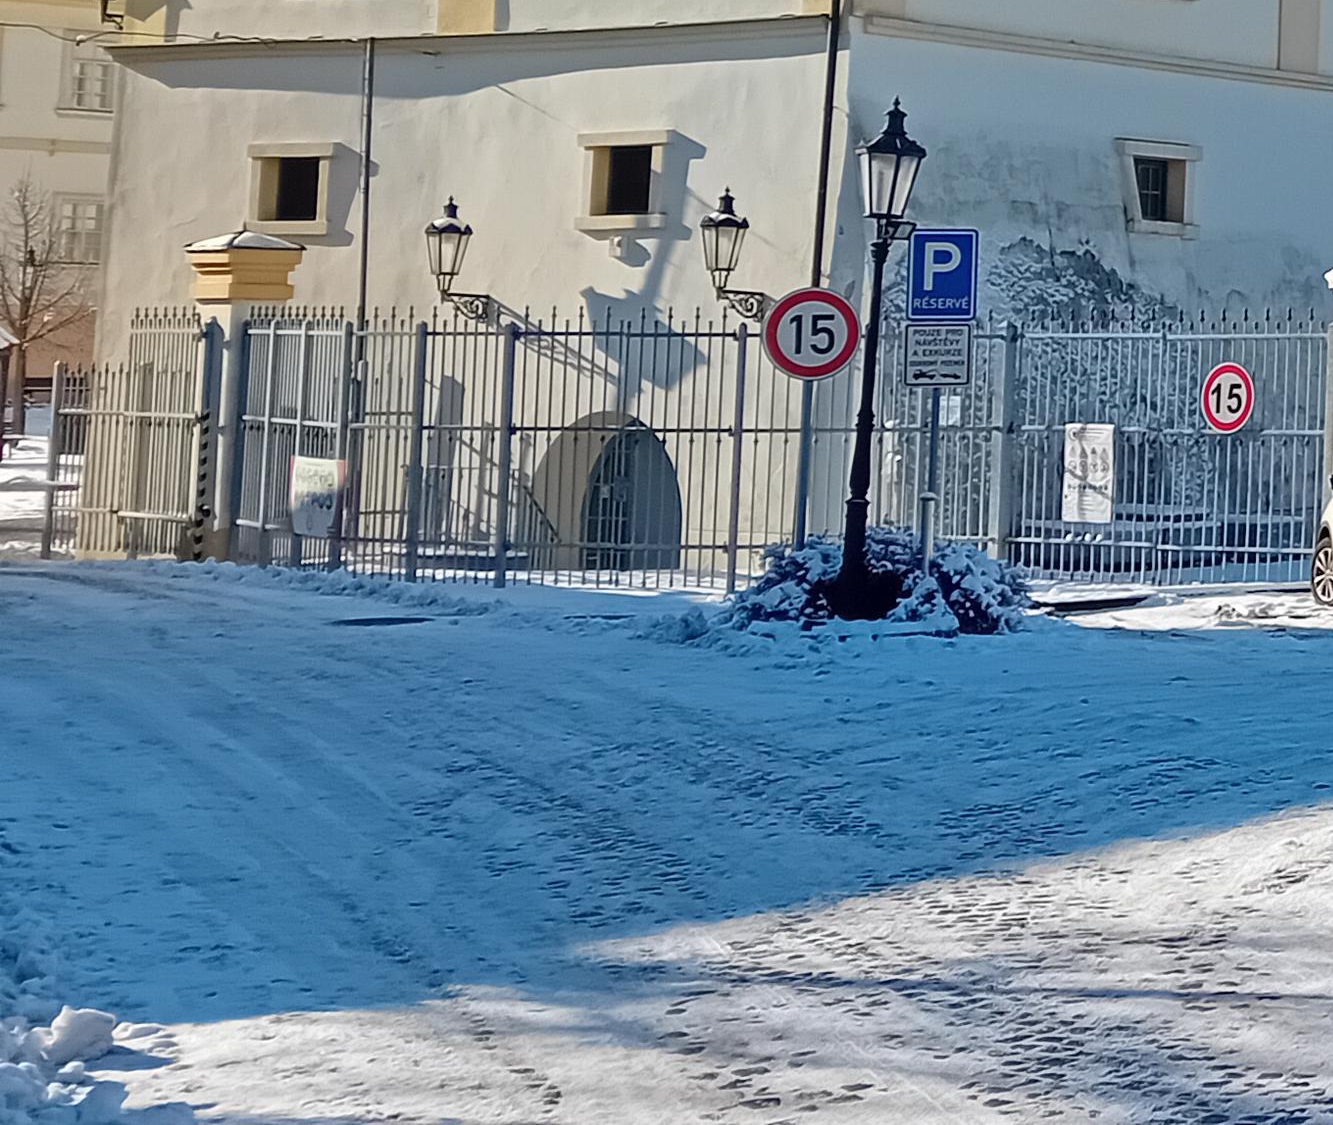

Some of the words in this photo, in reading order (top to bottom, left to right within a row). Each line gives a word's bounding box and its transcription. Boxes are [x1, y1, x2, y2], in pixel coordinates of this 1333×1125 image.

[923, 241, 961, 291] P
[913, 296, 969, 309] RÉSERVÉ
[789, 314, 836, 355] 15
[1211, 383, 1242, 414] 15
